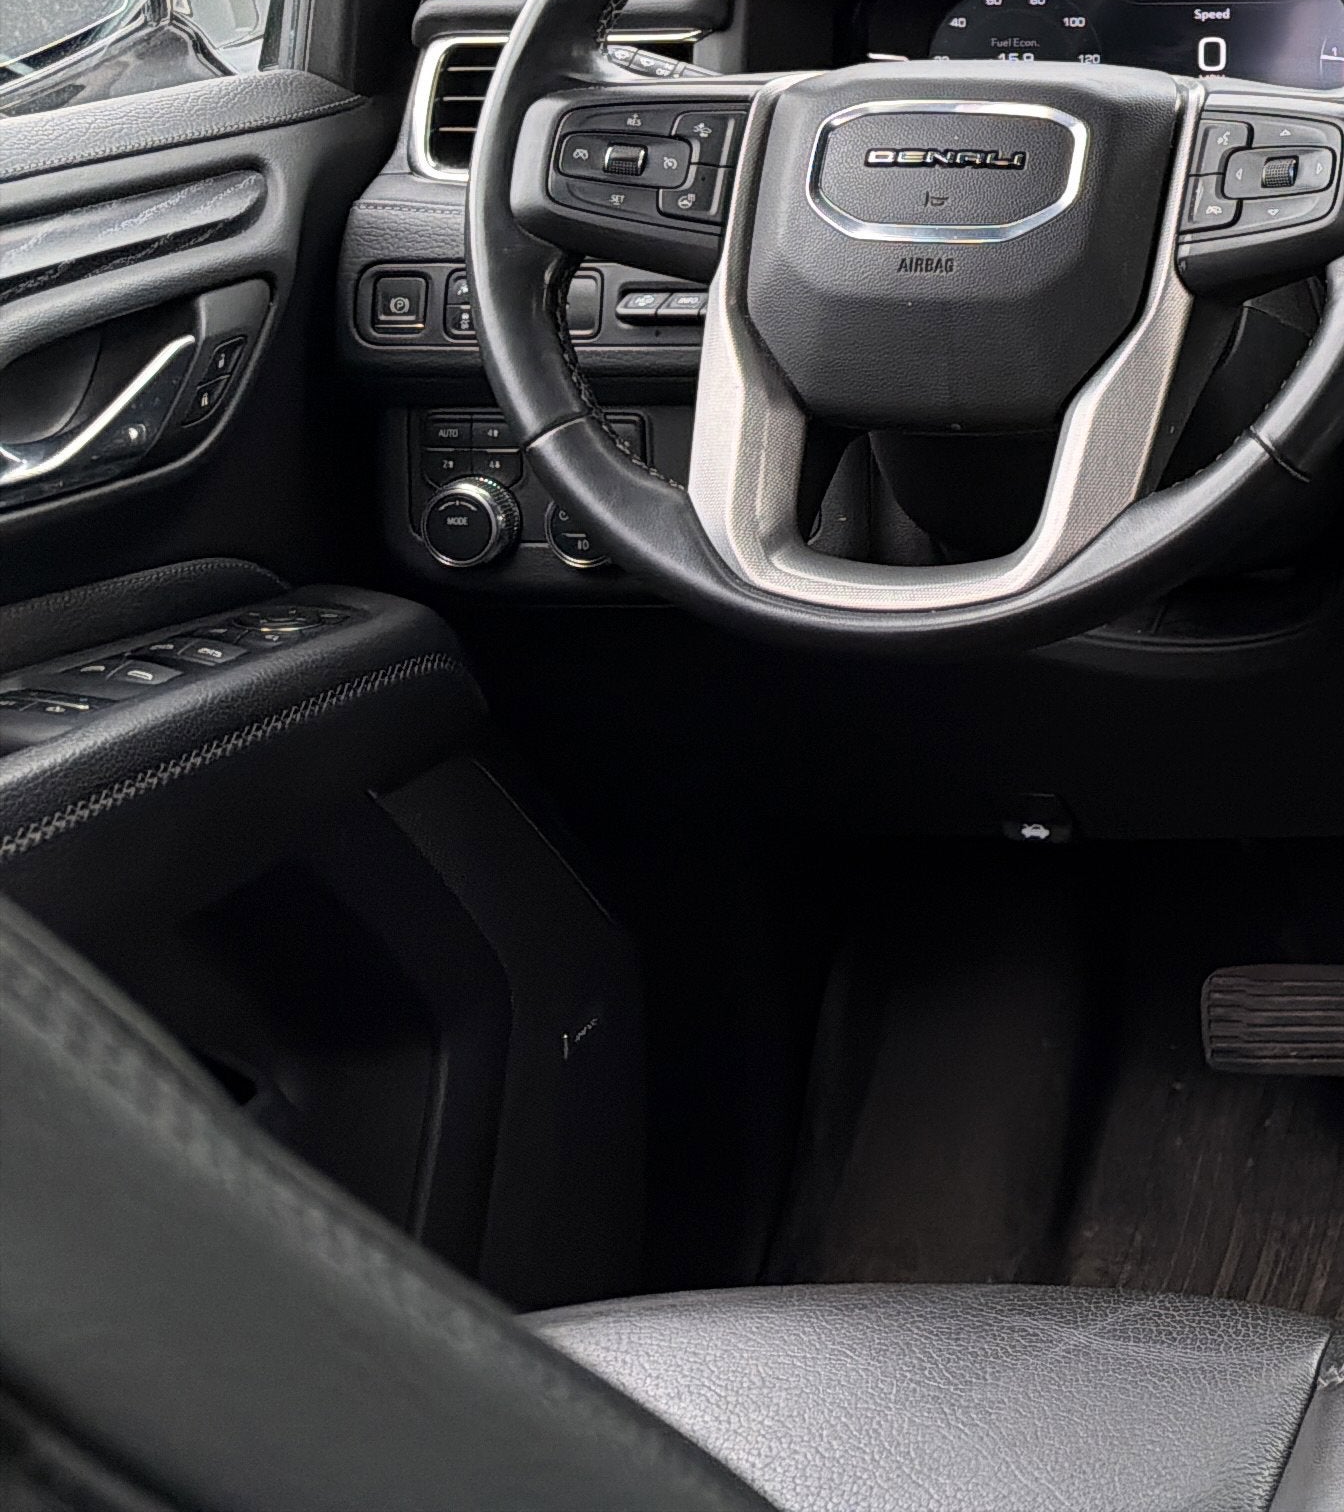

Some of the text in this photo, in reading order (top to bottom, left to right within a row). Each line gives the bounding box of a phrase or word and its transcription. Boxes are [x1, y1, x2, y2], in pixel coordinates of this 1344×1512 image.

[1194, 8, 1231, 22] Speed
[949, 17, 967, 28] 40
[1063, 17, 1086, 28] 100
[991, 38, 1041, 47] Fuel Econ.
[1078, 54, 1101, 64] 120
[1198, 36, 1227, 72] 0
[626, 118, 642, 127] RES
[866, 148, 1026, 169] DENALI
[609, 194, 625, 203] SET
[897, 257, 954, 273] AIRBAG
[438, 429, 459, 437] AUTO
[447, 517, 469, 526] MODE
